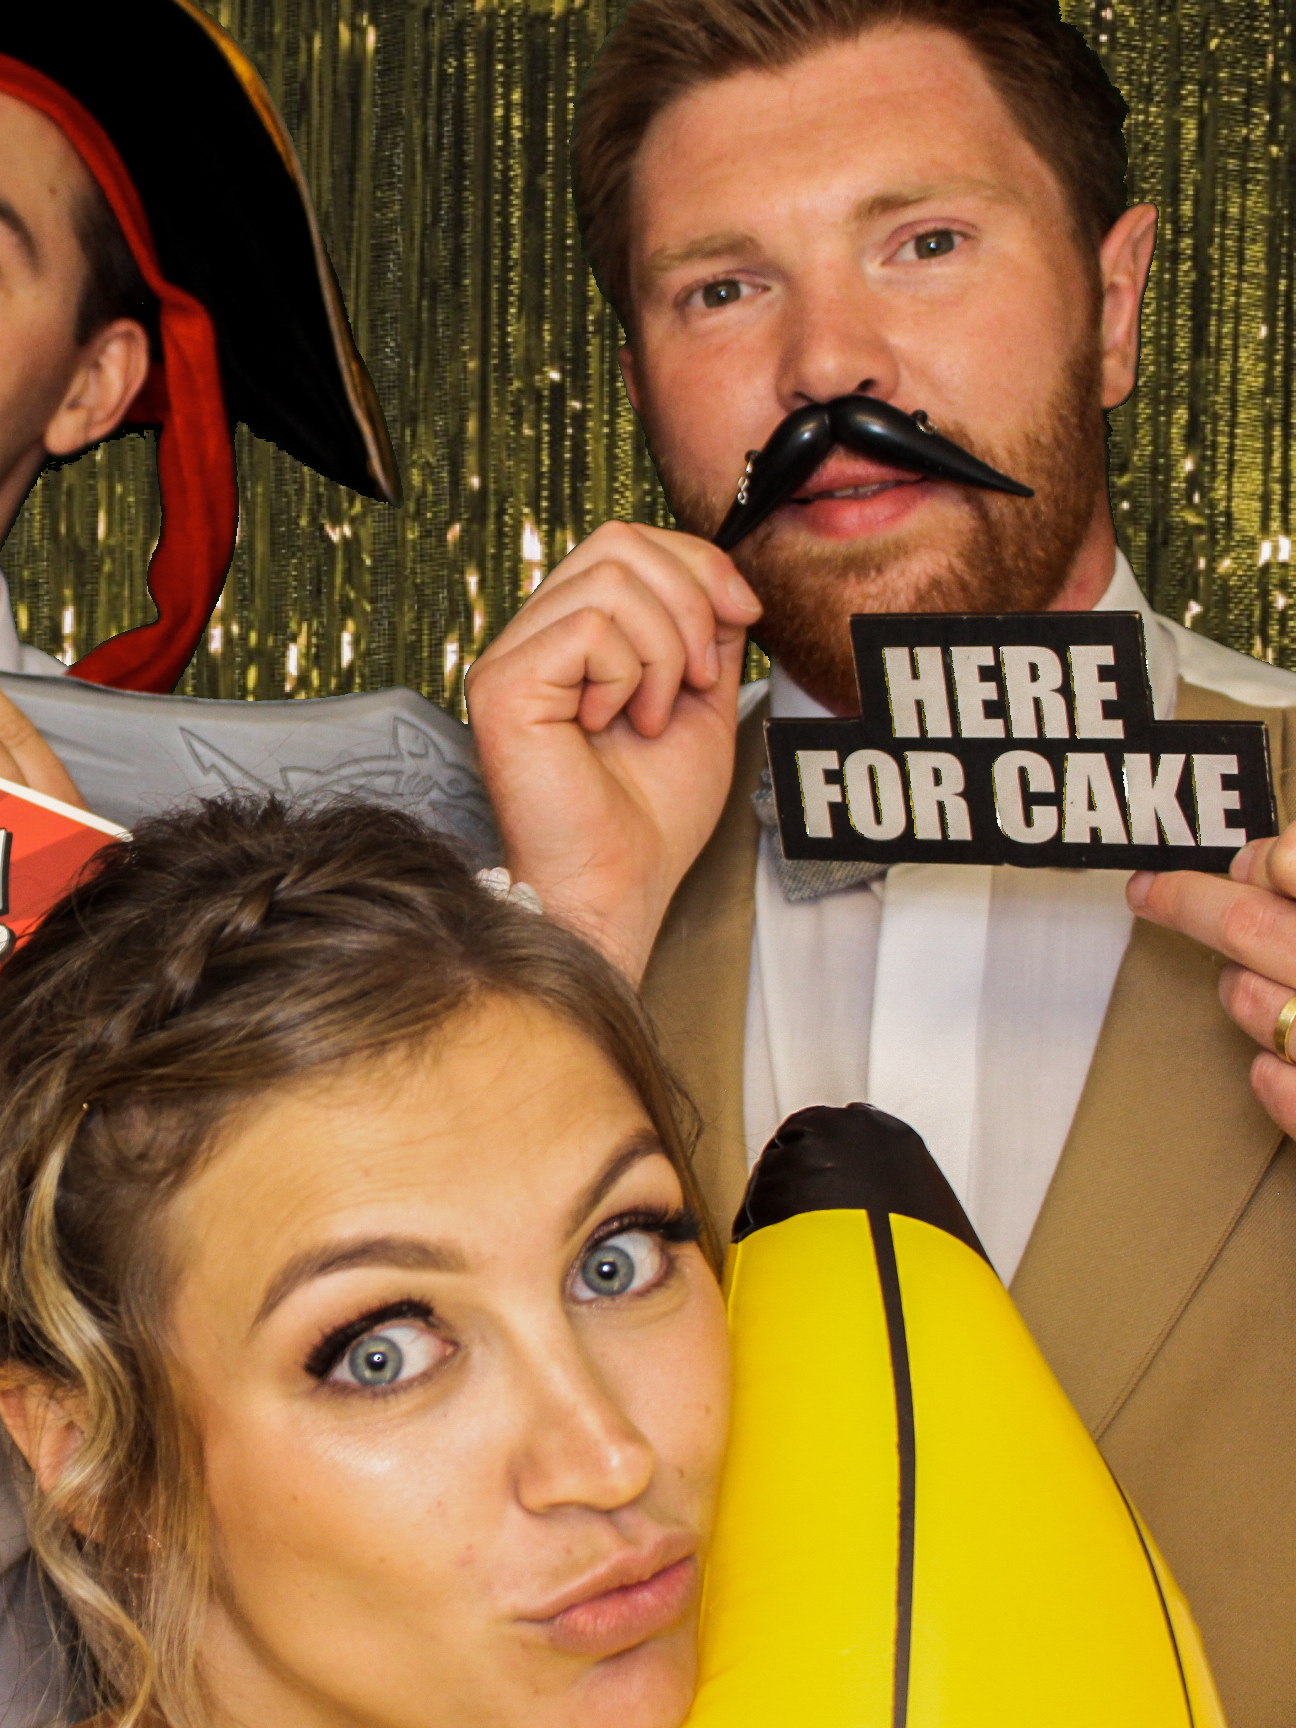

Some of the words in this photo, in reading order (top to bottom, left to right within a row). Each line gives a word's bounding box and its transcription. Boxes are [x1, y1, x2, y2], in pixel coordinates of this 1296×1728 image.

[881, 644, 1125, 740] HERE
[794, 748, 973, 842] FOR
[991, 749, 1248, 848] CAKE
